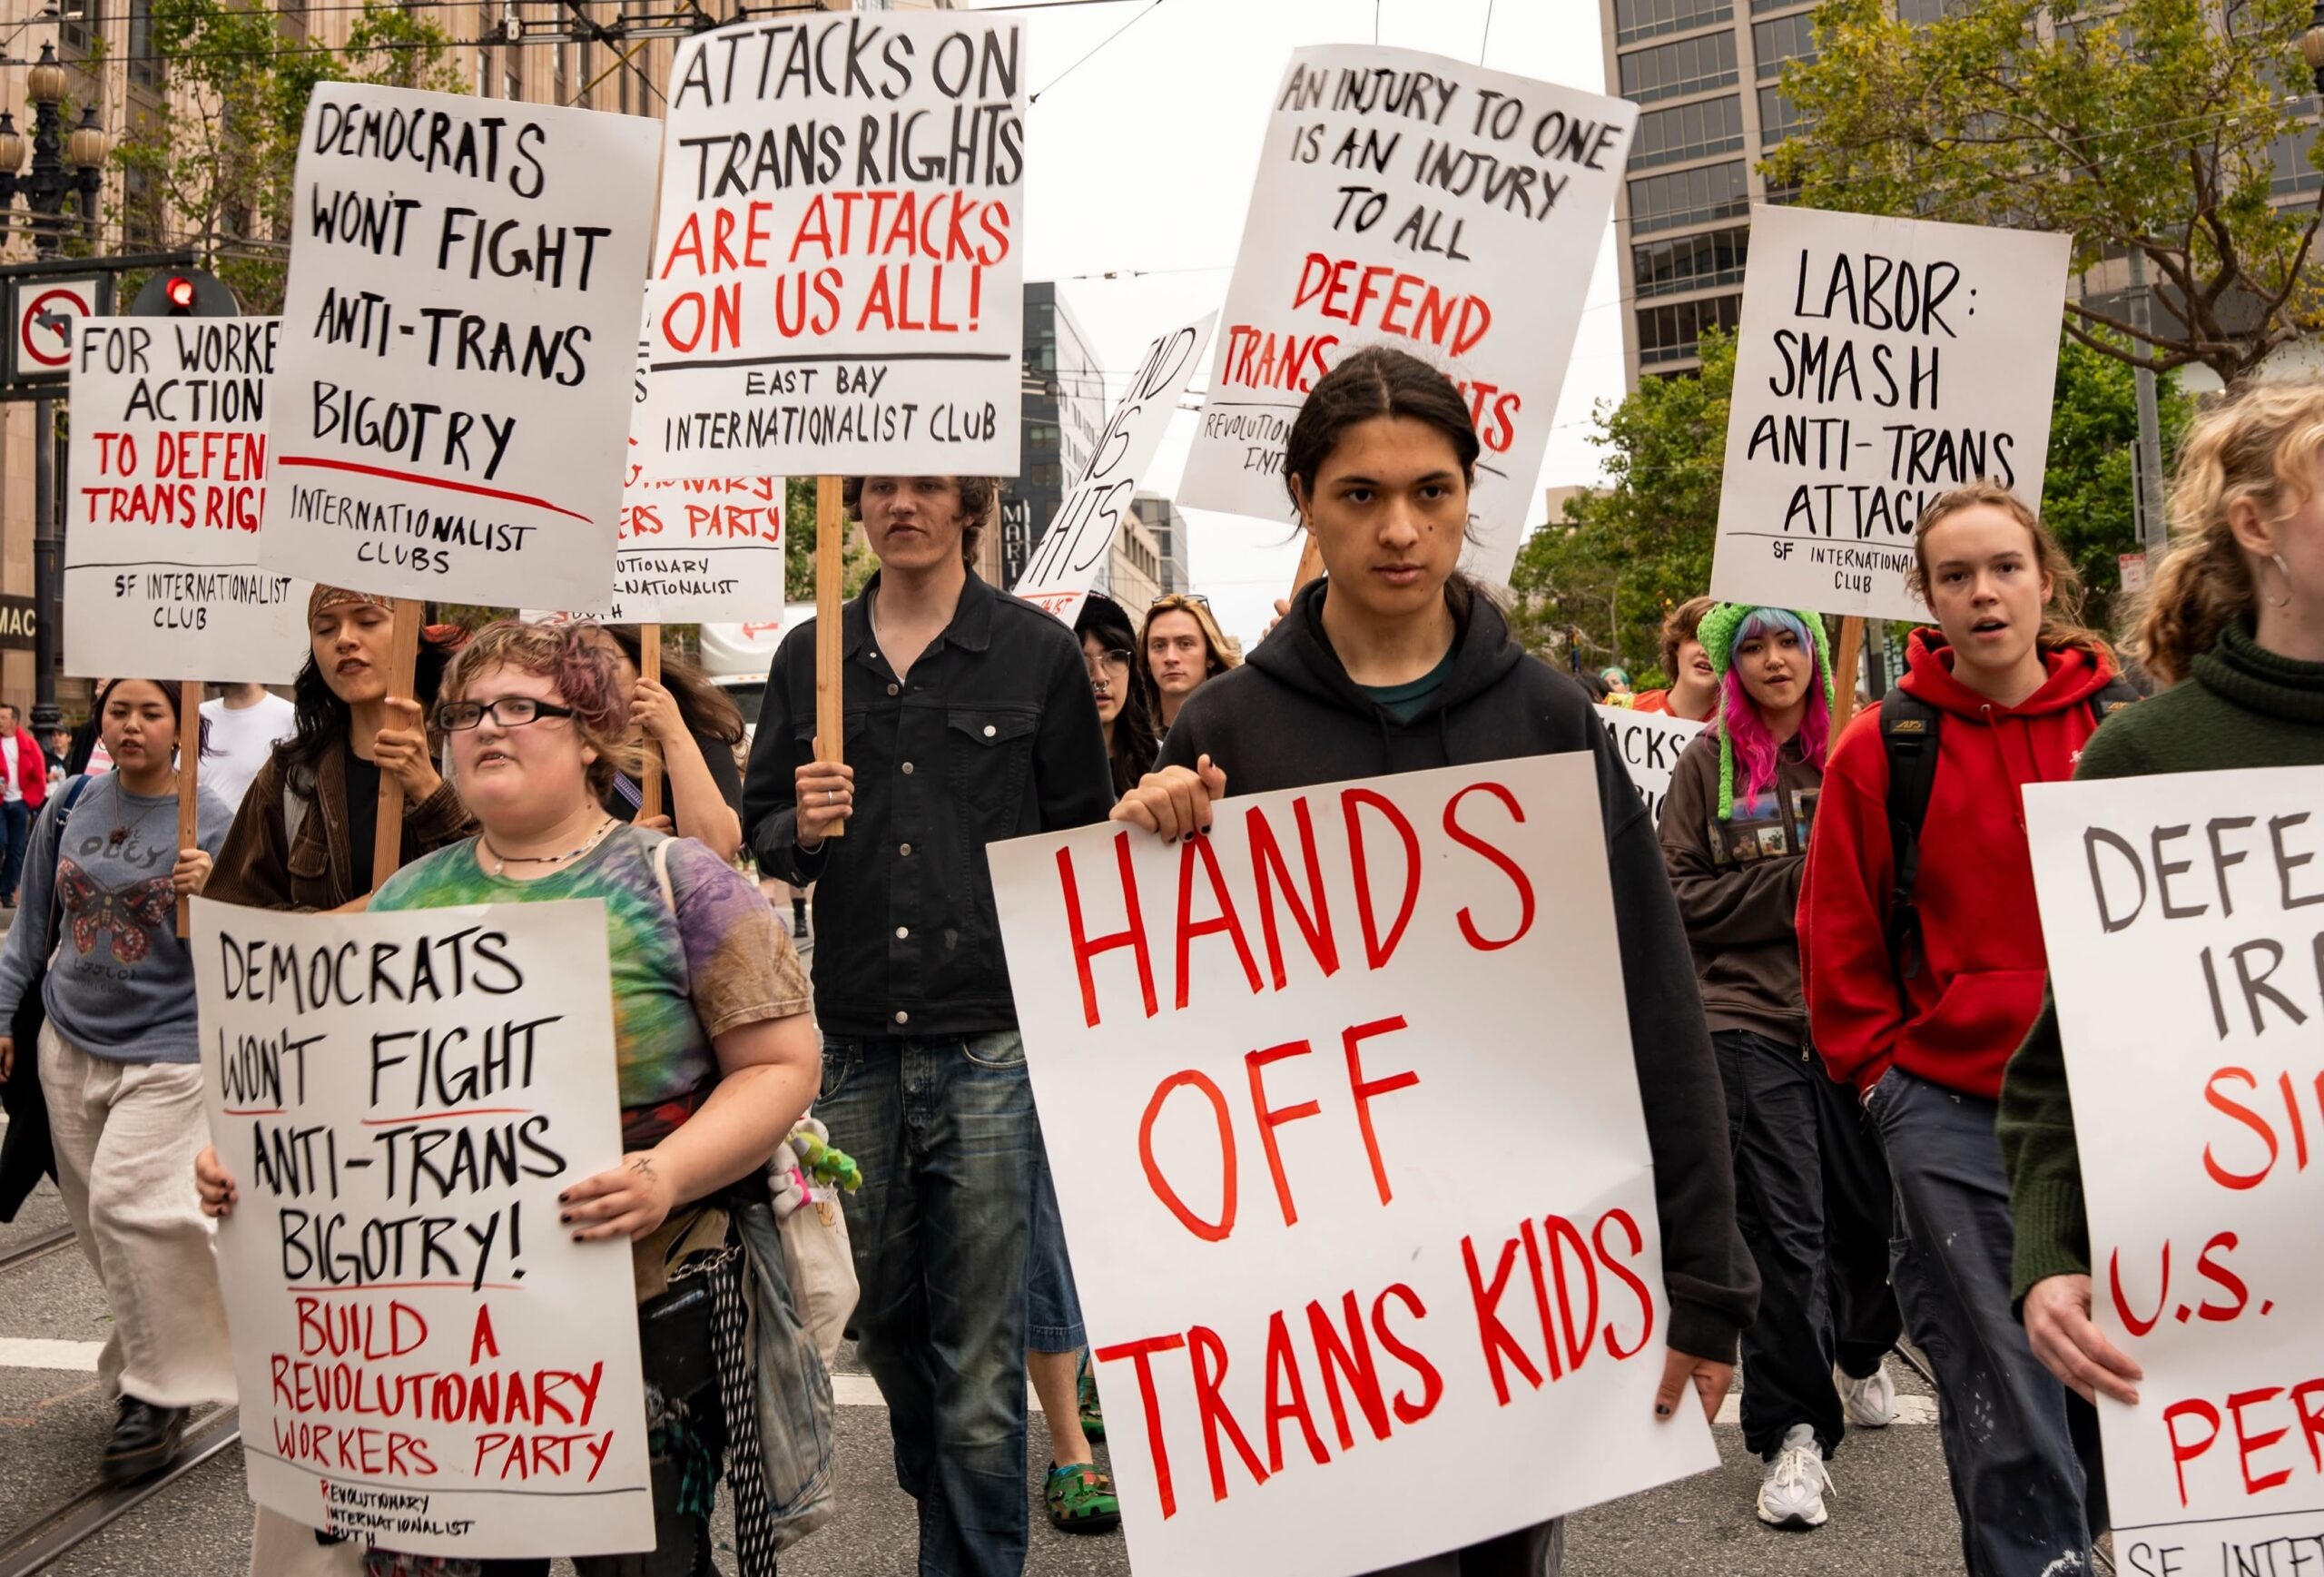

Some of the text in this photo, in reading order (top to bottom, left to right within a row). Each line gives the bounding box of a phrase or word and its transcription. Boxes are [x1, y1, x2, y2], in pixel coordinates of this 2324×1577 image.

[675, 16, 1020, 110] ATTACKS ON
[313, 102, 547, 200] DEMOCRATS
[679, 103, 1024, 201] TRANS RIGHTS
[1277, 63, 1624, 172] AN INJURY TO ONE
[1289, 123, 1570, 223] IS AN INJURY
[437, 207, 613, 292] FIGHT
[661, 190, 1010, 281] ARE ATTACKS
[1331, 185, 1472, 262] TO ALL
[661, 281, 743, 354] ON
[775, 266, 844, 338] US
[856, 263, 982, 333] ALL!
[1291, 251, 1492, 359] DEFEND
[1793, 248, 1978, 340] LABOR:
[82, 320, 281, 375] FOR WORKE
[745, 364, 889, 399] EAST BAY
[1128, 327, 1197, 404] ND
[1768, 329, 1941, 411] SMASH
[123, 377, 264, 423] ACTION
[312, 379, 517, 481] BIGOTRY
[665, 401, 998, 453] INTERNATIONALIST CLUB
[1204, 413, 1289, 446] REVOLUTION
[92, 430, 269, 482] TO DEFEN
[1243, 447, 1286, 476] INT
[80, 483, 197, 529] TRANS
[290, 484, 537, 553] INTERNATIONALIST
[684, 503, 780, 543] PARTY
[1028, 478, 1135, 588] HTS
[114, 573, 292, 606] SF INTERNATIONALIST
[357, 542, 452, 575] CLUBS
[614, 578, 740, 596] NATIONALIST
[616, 557, 709, 575] UTIONARY
[1773, 540, 1914, 574] SF INTERNATIONAL
[1834, 571, 1873, 595] CLUB
[153, 606, 208, 630] CLUB
[1055, 781, 1536, 1029] HANDS
[2083, 811, 2324, 935] DEFE
[219, 924, 525, 1015] DEMOCRATS
[2199, 931, 2324, 1042] IR
[219, 1015, 565, 1110] WON'T FIGHT
[252, 1114, 568, 1207] ANTI-TRANS
[1137, 1014, 1422, 1243] OFF
[2202, 1066, 2324, 1191] SI
[280, 1199, 527, 1293] BIGOTRY!
[2107, 1230, 2275, 1337] U.S.
[294, 1297, 500, 1366] BUILD A
[1094, 1207, 1655, 1521] TRANS KIDS
[271, 1354, 605, 1428] REVOLUTIONARY
[271, 1419, 614, 1483] WORKERS PARTY
[2162, 1377, 2324, 1509] PER
[320, 1479, 430, 1515] REVOLUTIONARY
[2221, 1533, 2324, 1577] INTE
